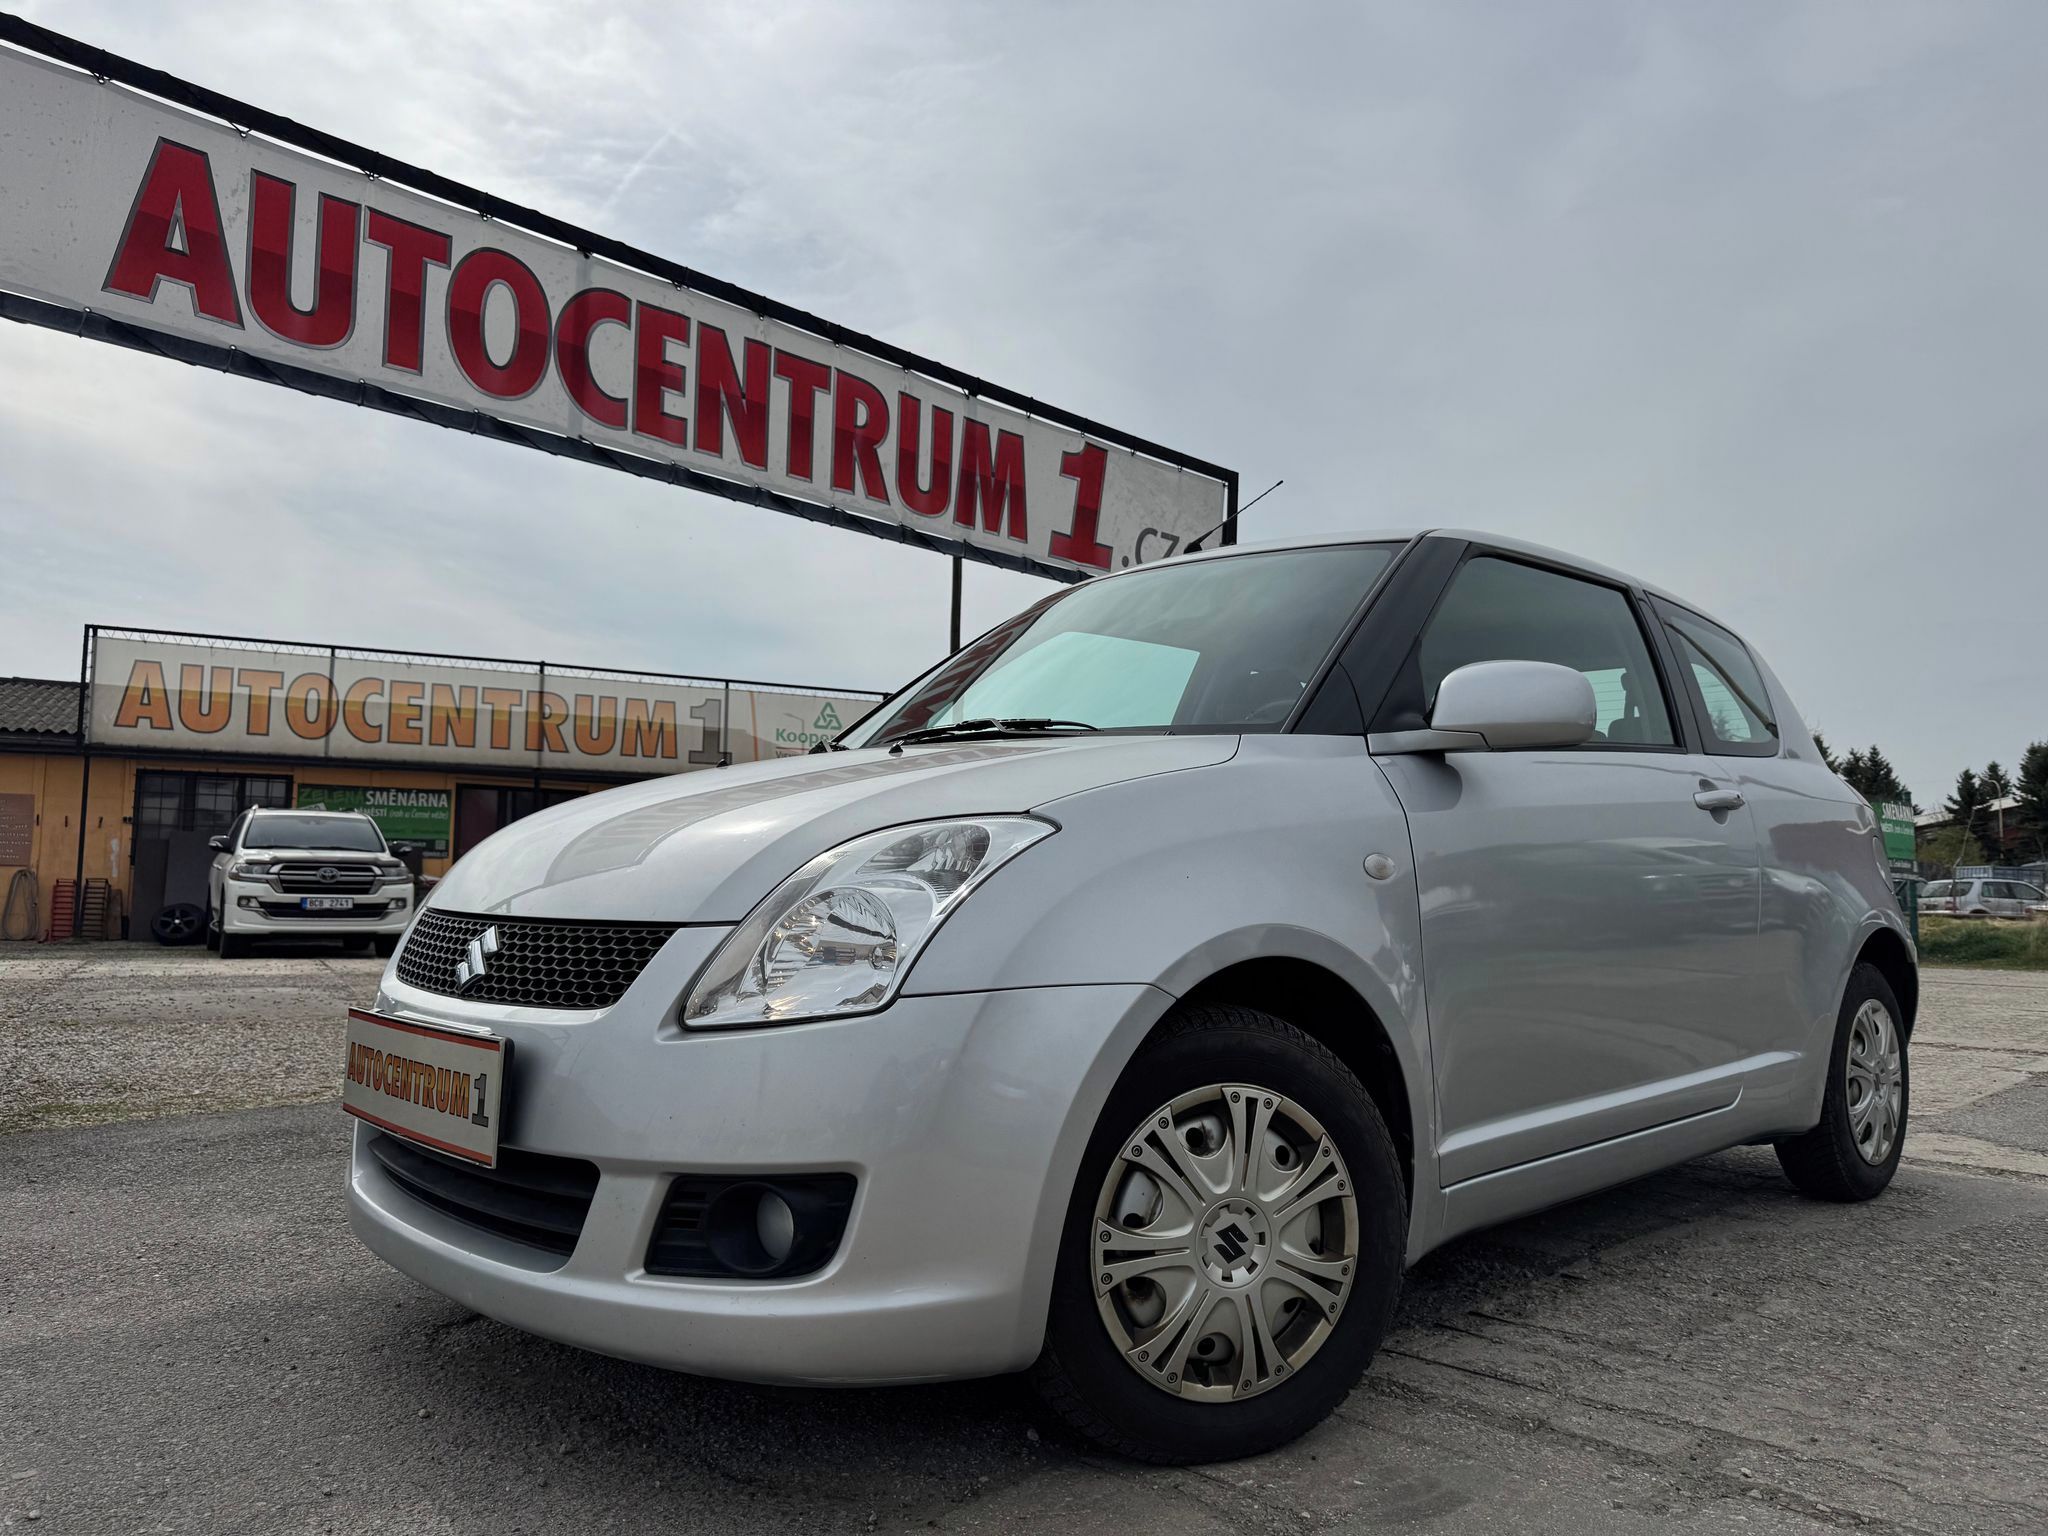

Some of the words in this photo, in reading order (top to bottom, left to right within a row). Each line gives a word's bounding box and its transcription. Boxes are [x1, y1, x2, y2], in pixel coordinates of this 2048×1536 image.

[101, 136, 1028, 544] AUTOCENTRUM
[1048, 441, 1114, 572] 1
[113, 659, 679, 760] AUTOCENTRUM
[688, 698, 733, 766] 1
[365, 788, 449, 808] SMĚNÁRNA
[347, 1041, 471, 1119] AUTOCENTRUM
[471, 1073, 489, 1128] 1
